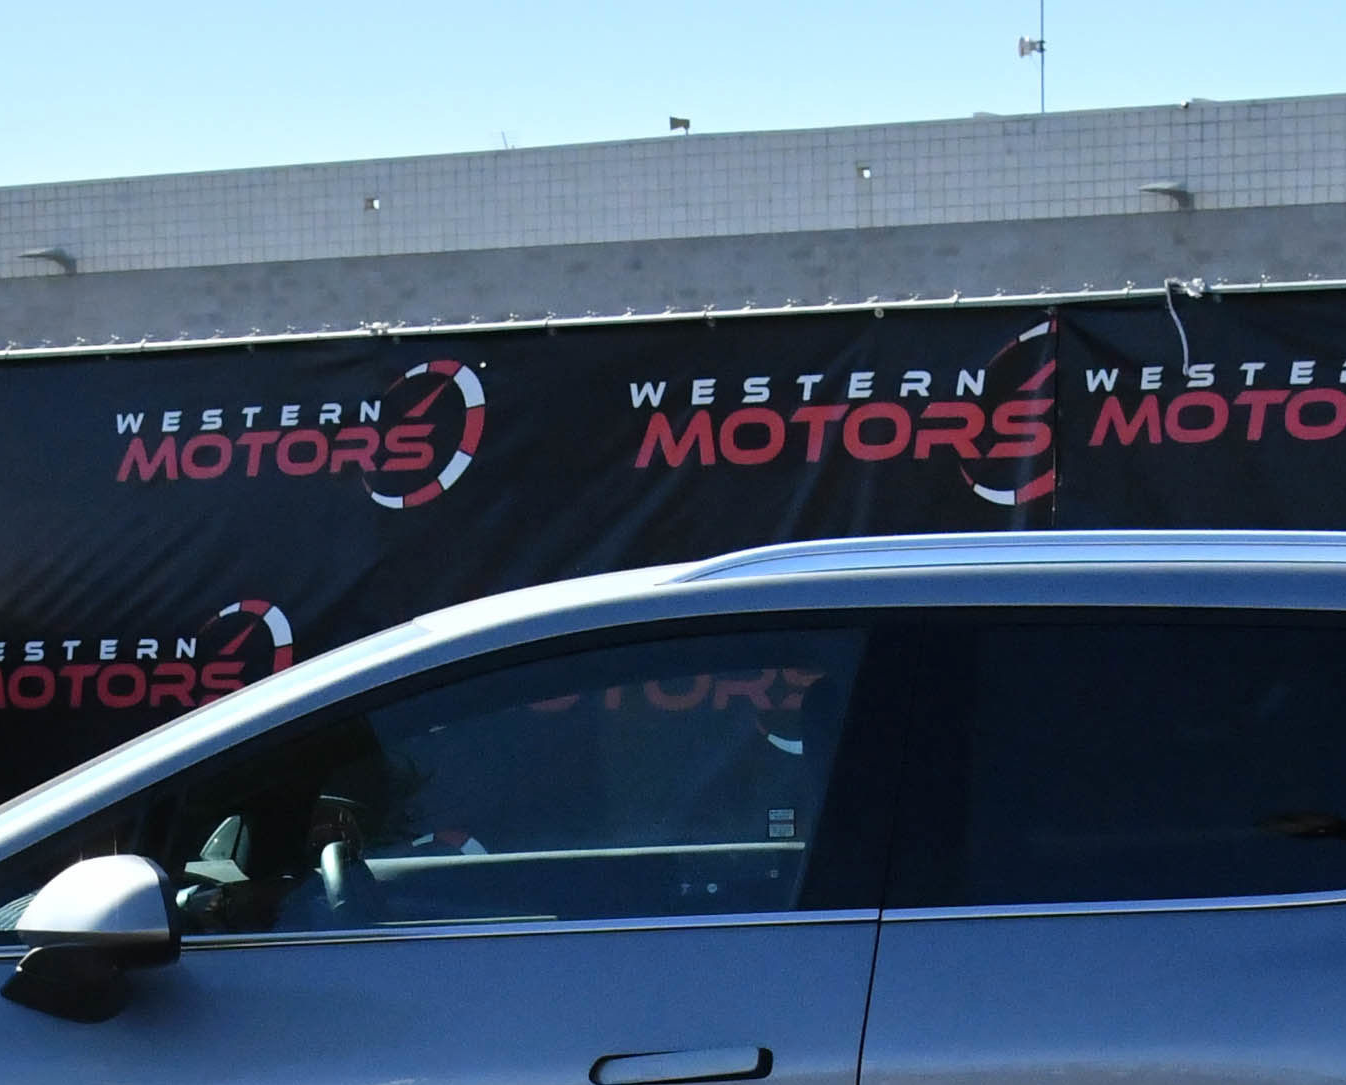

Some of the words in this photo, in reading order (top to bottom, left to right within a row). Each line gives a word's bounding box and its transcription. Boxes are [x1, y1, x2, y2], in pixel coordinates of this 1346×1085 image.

[630, 370, 985, 408] WESTERN
[117, 401, 381, 434] WESTERN
[634, 398, 1055, 468] MOTORS
[117, 424, 435, 481] MOTORS
